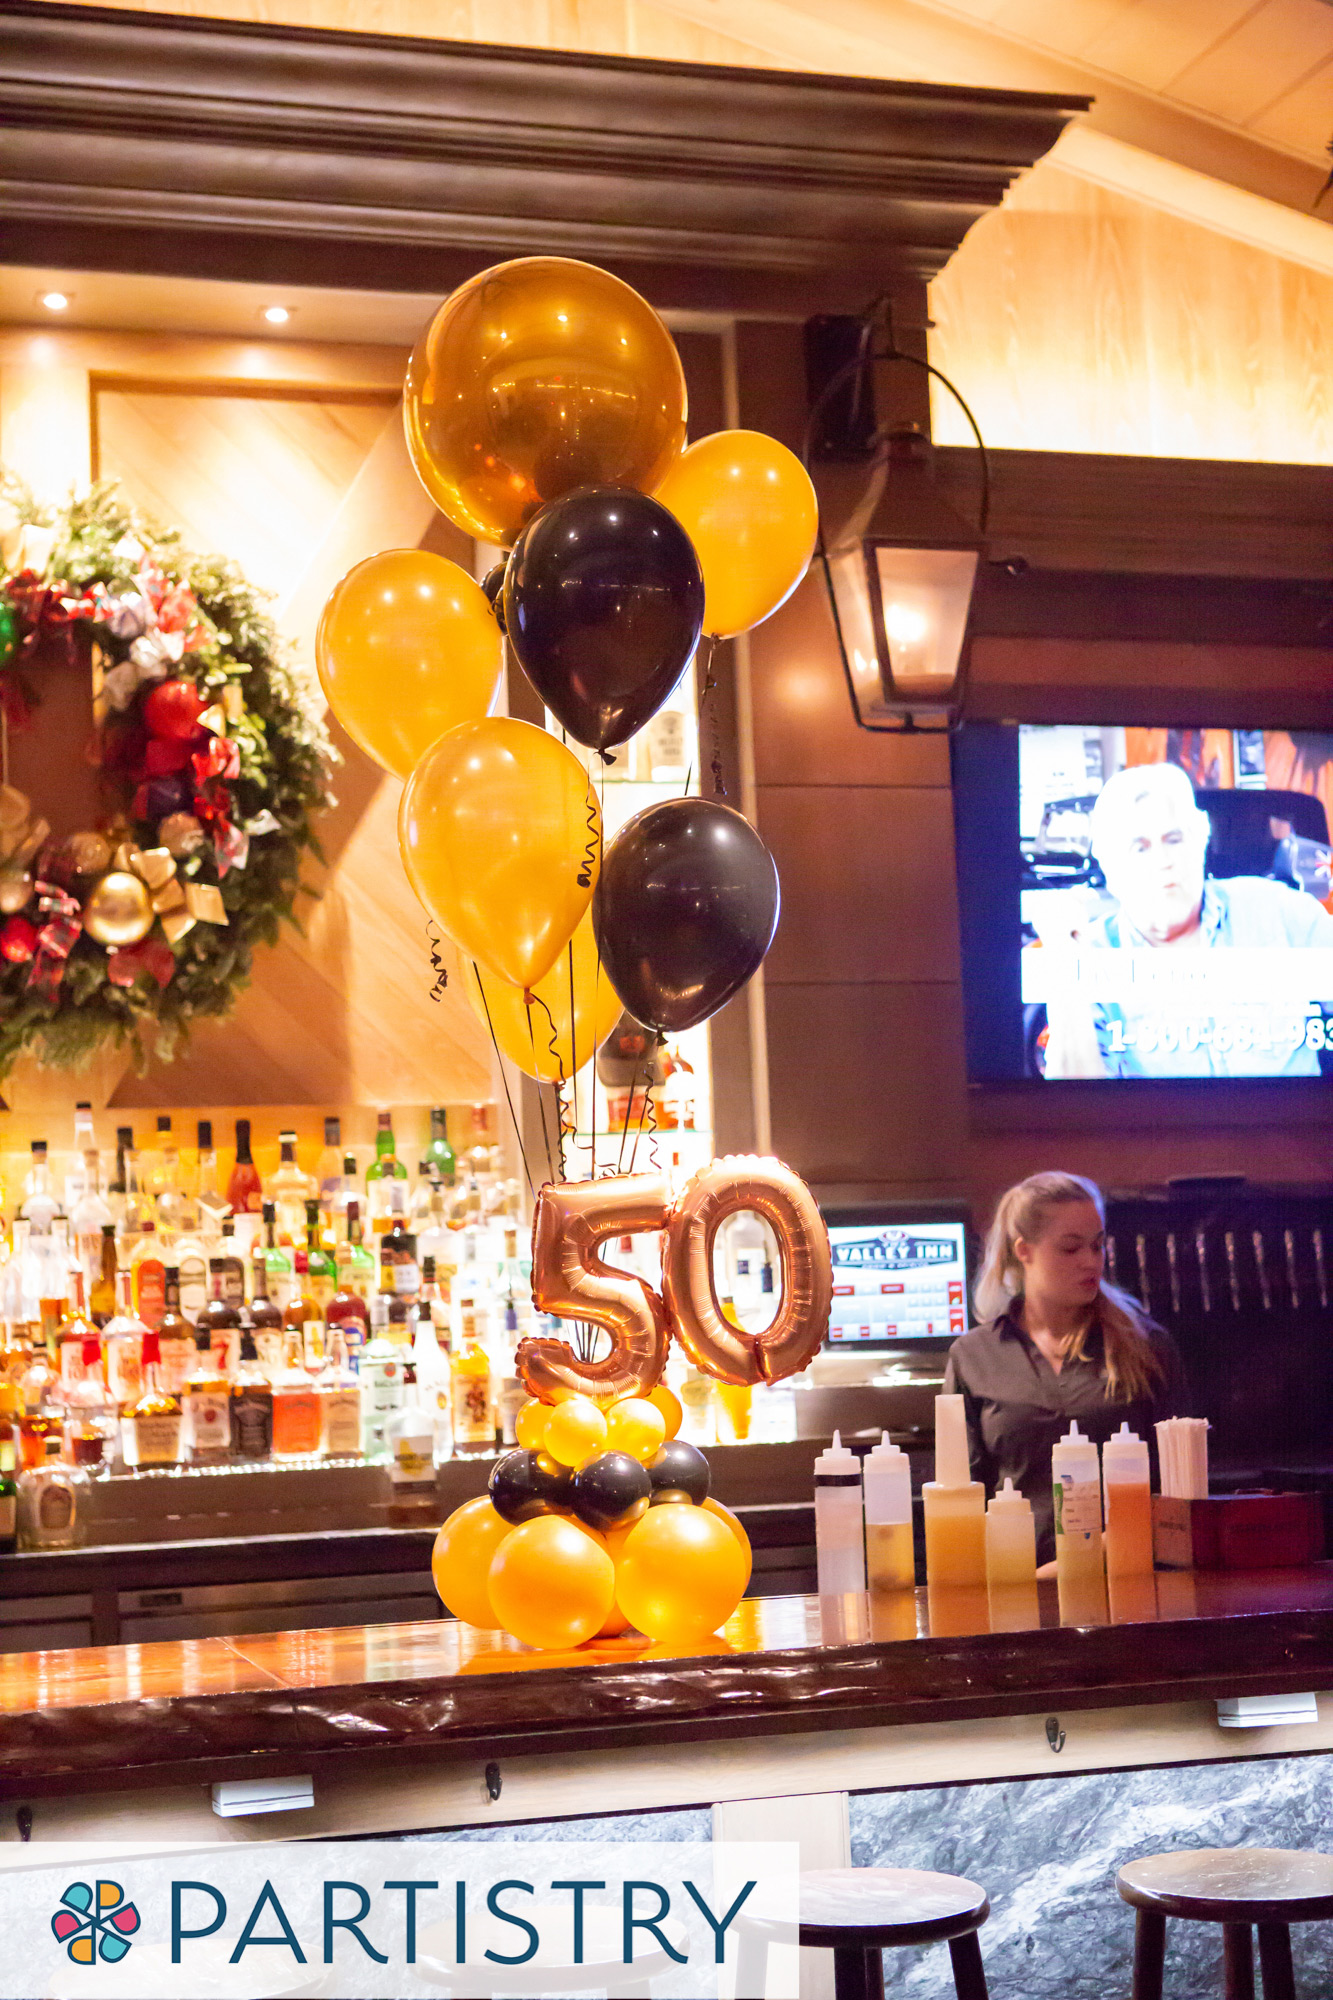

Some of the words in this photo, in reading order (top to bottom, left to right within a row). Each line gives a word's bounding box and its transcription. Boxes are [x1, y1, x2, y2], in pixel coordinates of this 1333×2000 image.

[514, 1153, 833, 1405] 50
[836, 1246, 910, 1261] VALLEY
[916, 1244, 953, 1258] INN
